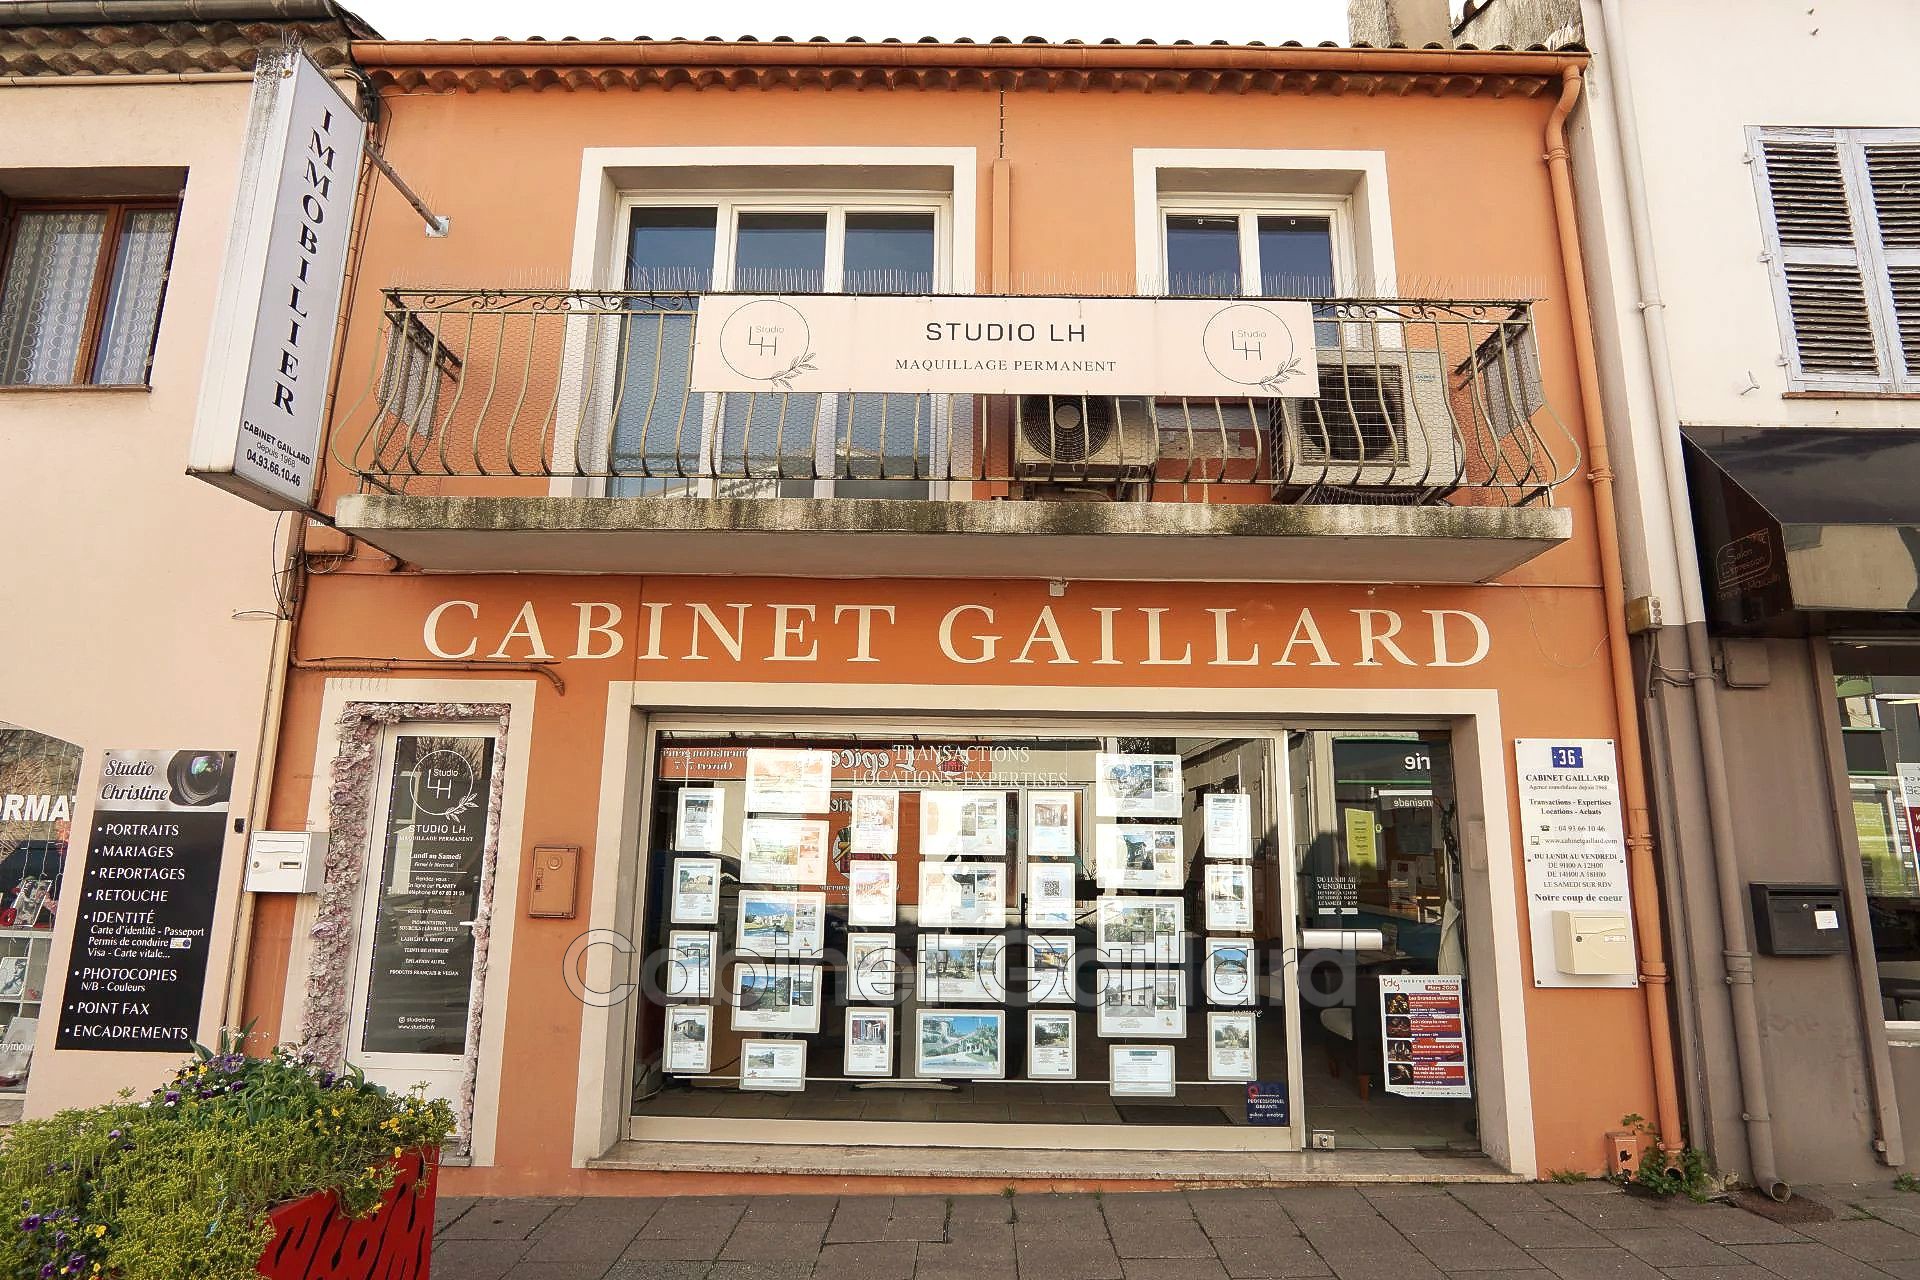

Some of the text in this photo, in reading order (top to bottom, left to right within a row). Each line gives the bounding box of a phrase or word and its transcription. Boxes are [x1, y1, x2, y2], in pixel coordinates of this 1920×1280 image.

[272, 106, 336, 416] IMMOBILIER
[755, 325, 785, 334] Studio
[926, 322, 1086, 342] STUDIO LH
[1238, 330, 1267, 338] Studio
[895, 359, 1116, 372] MAQUILLAGE PERMANENT
[244, 420, 311, 465] CABINET GAILLARD
[257, 442, 296, 468] depuis 1968
[247, 448, 301, 487] 04.93.66.10.46
[423, 600, 1491, 667] CABINET GAILLARD
[893, 745, 1030, 763] TRANSACTIONS
[1558, 750, 1576, 765] 36
[105, 759, 154, 776] Studio
[434, 768, 459, 777] Studio
[101, 783, 168, 800] Christine
[1577, 799, 1612, 807] Expertises
[105, 824, 180, 836] PORTRAITS
[409, 824, 466, 834] STUDIO LH
[102, 846, 174, 858] MARIAGES
[99, 867, 185, 880] REPORTAGES
[95, 889, 169, 902] RETOUCHE
[1535, 894, 1560, 902] Notre
[1562, 895, 1583, 904] coup
[1586, 894, 1596, 902] de
[92, 909, 156, 924] IDENTITÉ
[91, 925, 204, 938] Carte d'identité Passeport
[88, 937, 169, 947] Permis de conduire
[88, 948, 106, 958] Visa
[114, 948, 137, 958] Carte
[83, 968, 177, 981] PHOTOCOPIES
[81, 982, 146, 992] N/B Couleurs
[77, 1002, 150, 1015] POINT FAX
[73, 1025, 188, 1040] ENCADREMENTS
